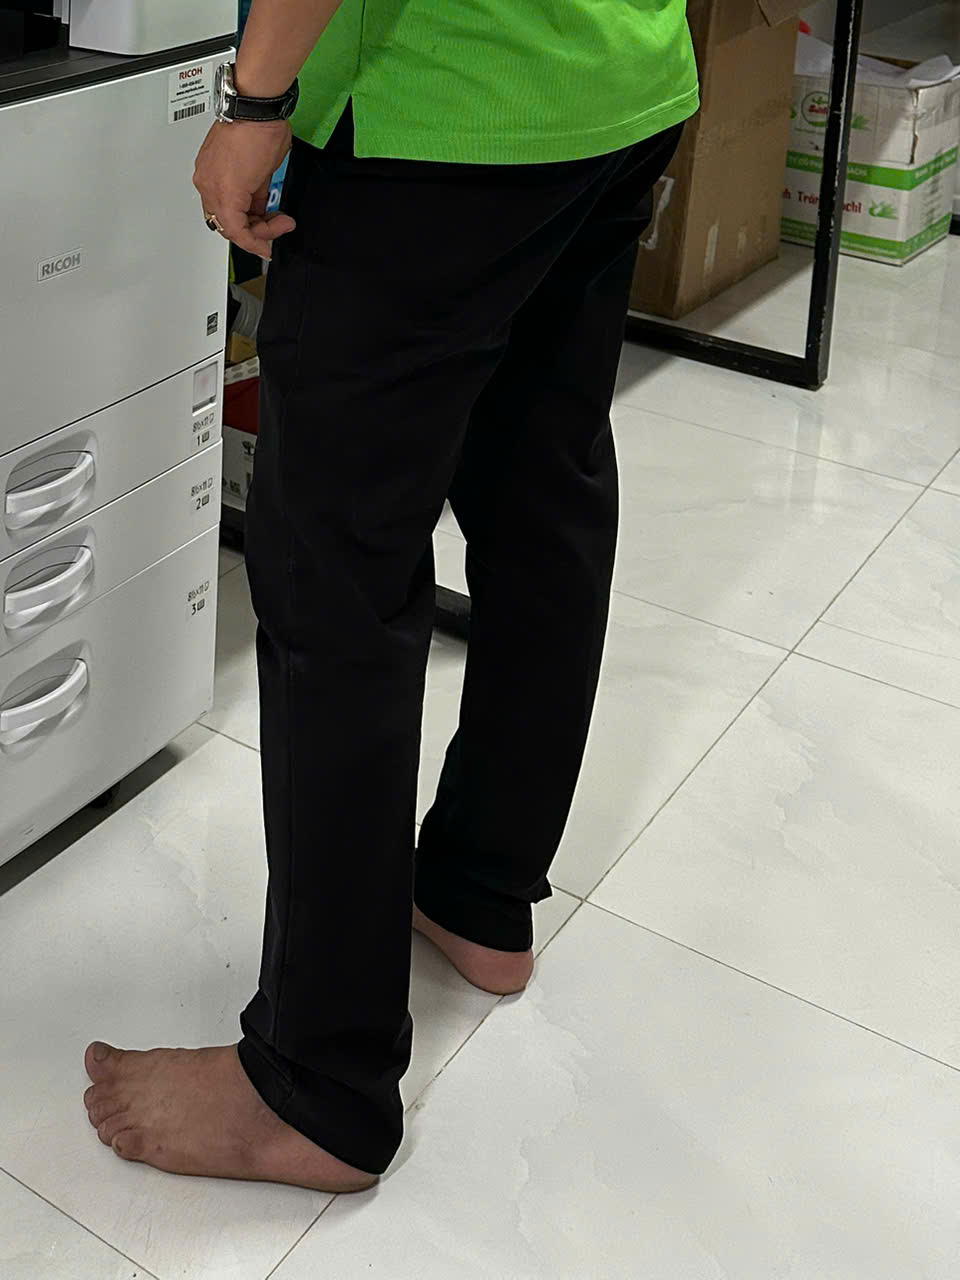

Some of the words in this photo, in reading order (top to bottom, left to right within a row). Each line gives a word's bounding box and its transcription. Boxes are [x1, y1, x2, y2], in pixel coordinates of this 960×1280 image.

[179, 66, 203, 80] RICOH
[41, 252, 81, 277] RICOH
[195, 497, 202, 510] 2
[191, 603, 197, 616] 3
